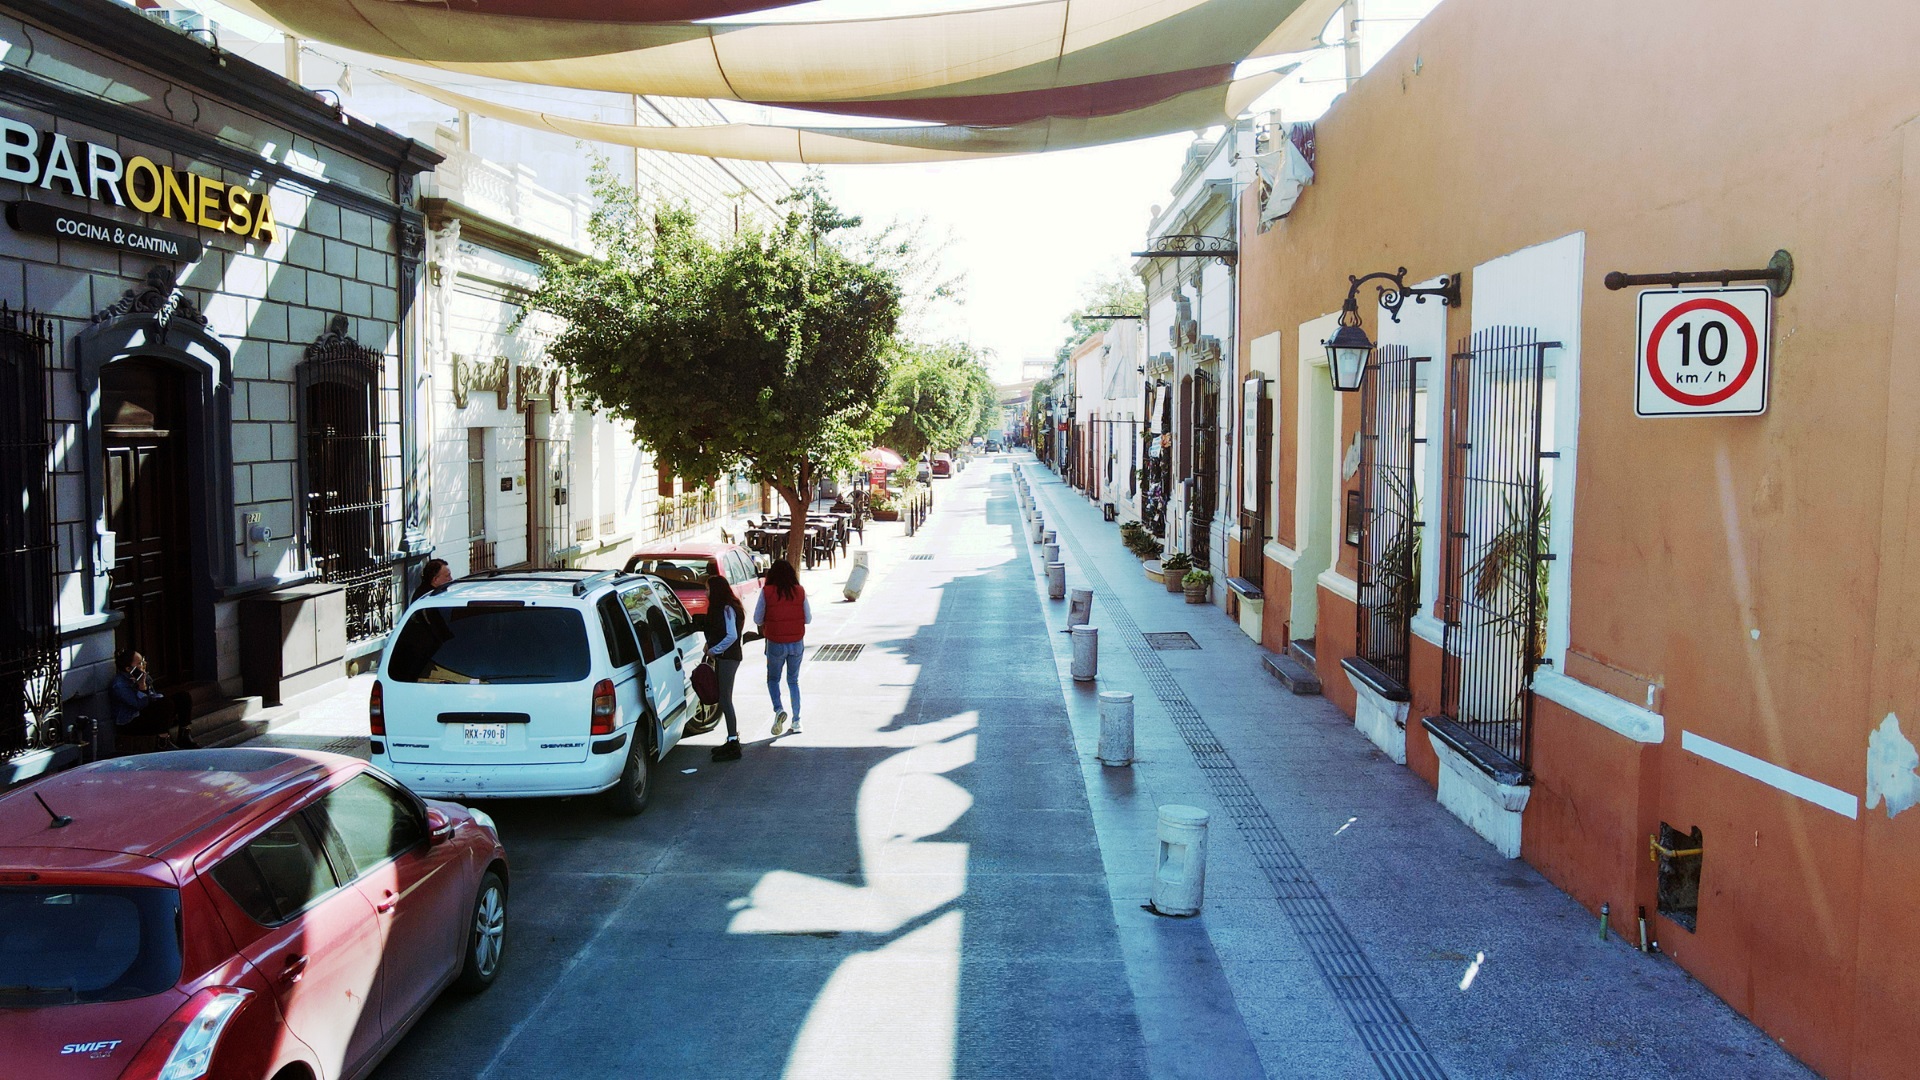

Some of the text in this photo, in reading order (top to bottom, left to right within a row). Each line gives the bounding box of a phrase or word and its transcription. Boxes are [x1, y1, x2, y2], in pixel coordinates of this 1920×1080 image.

[0, 116, 279, 243] BARONESA
[56, 217, 179, 255] COCINA & CANTINA
[1676, 320, 1728, 367] 10
[1676, 371, 1726, 383] km/h
[464, 729, 505, 739] RKX-790-B
[60, 1040, 122, 1054] SWIFT
